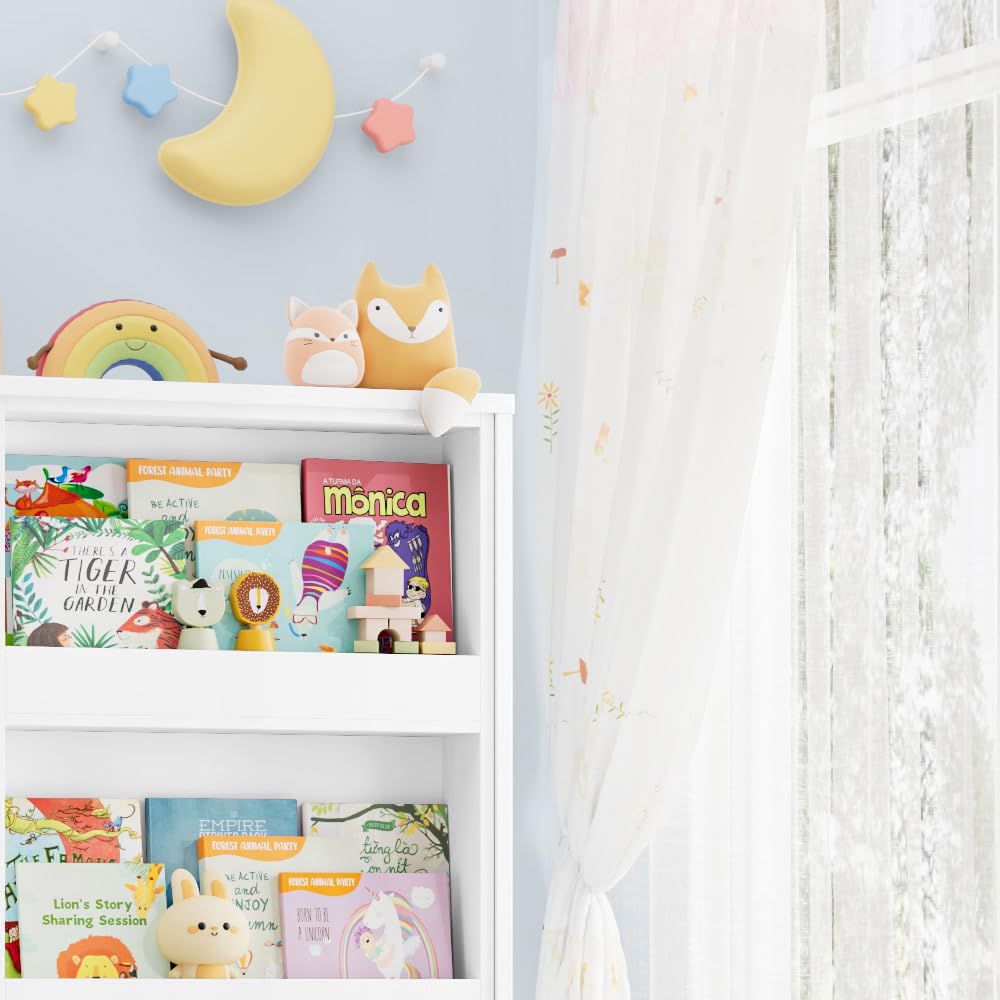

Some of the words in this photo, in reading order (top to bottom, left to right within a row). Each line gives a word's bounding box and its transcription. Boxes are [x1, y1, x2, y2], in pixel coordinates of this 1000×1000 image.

[137, 465, 167, 476] FOREST
[169, 466, 204, 477] ANIMAL
[206, 467, 232, 478] PARTY
[323, 477, 328, 485] A
[328, 477, 351, 485] TURMA
[151, 499, 163, 508] BE
[166, 498, 200, 508] ACTIVE
[161, 511, 190, 522] and
[203, 525, 226, 535] FOREST
[228, 526, 255, 535] ANIMAL
[256, 527, 276, 537] PARTY
[72, 545, 115, 557] THERE'S
[120, 547, 129, 557] A
[58, 557, 137, 585] TIGER
[75, 584, 87, 594] IN
[95, 584, 119, 596] THE
[63, 596, 135, 613] GARDEN
[199, 819, 267, 832] EMPIRE
[211, 840, 238, 851] FOREST
[240, 841, 273, 851] ANIMAL
[274, 841, 298, 851] PARTY
[238, 871, 269, 881] ACTIVE
[288, 877, 309, 886] FOREST
[310, 877, 335, 887] ANIMAL
[336, 877, 356, 887] PARTY
[234, 883, 259, 896] and
[53, 898, 90, 910] Lion's
[95, 899, 132, 912] Story
[232, 898, 269, 912] NJOY
[42, 914, 94, 929] Sharing
[99, 914, 147, 926] Session
